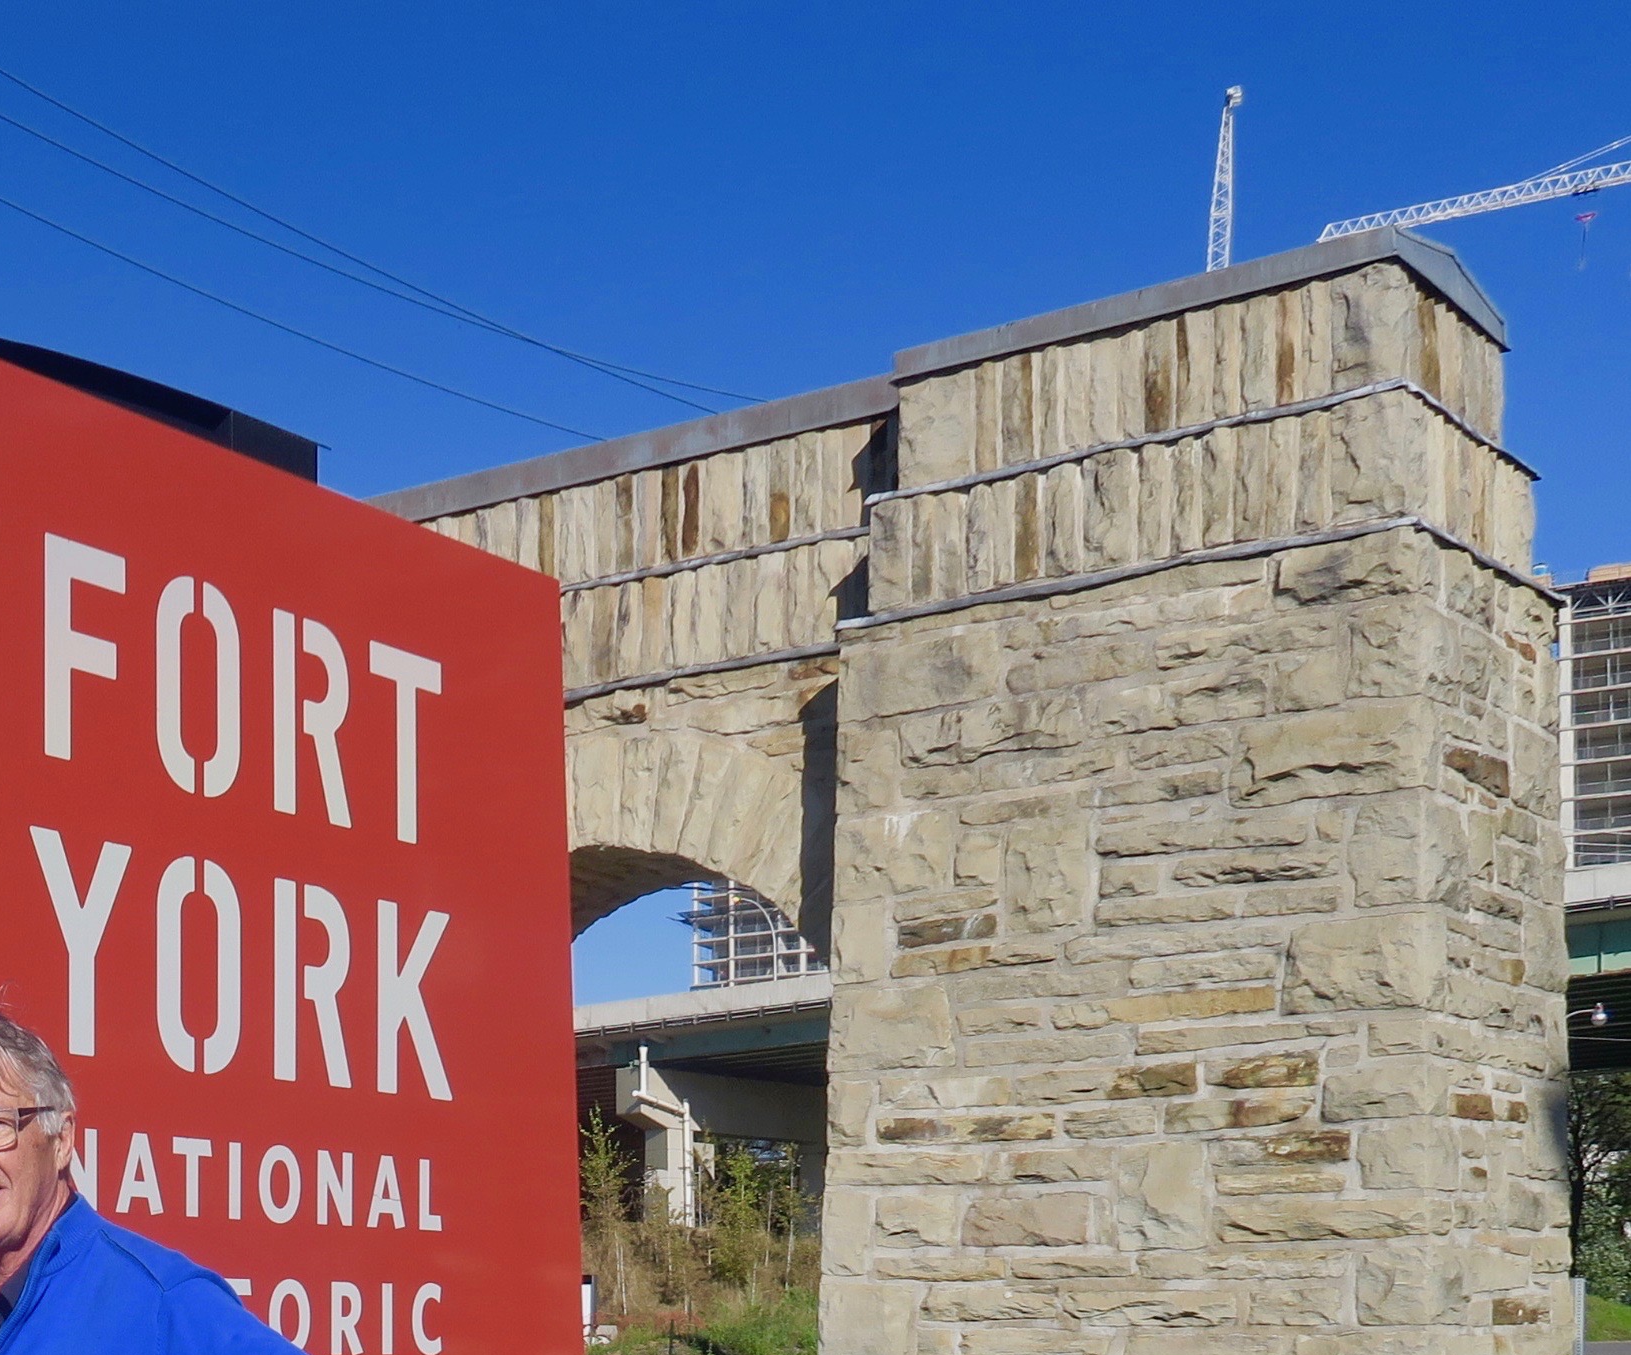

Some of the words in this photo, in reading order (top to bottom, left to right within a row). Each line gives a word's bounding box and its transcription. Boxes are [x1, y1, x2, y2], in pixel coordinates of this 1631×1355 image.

[44, 532, 442, 844] FORT
[29, 826, 452, 1101] YORK
[70, 1128, 442, 1231] NATIONAL
[225, 1278, 442, 1355] ORIC
